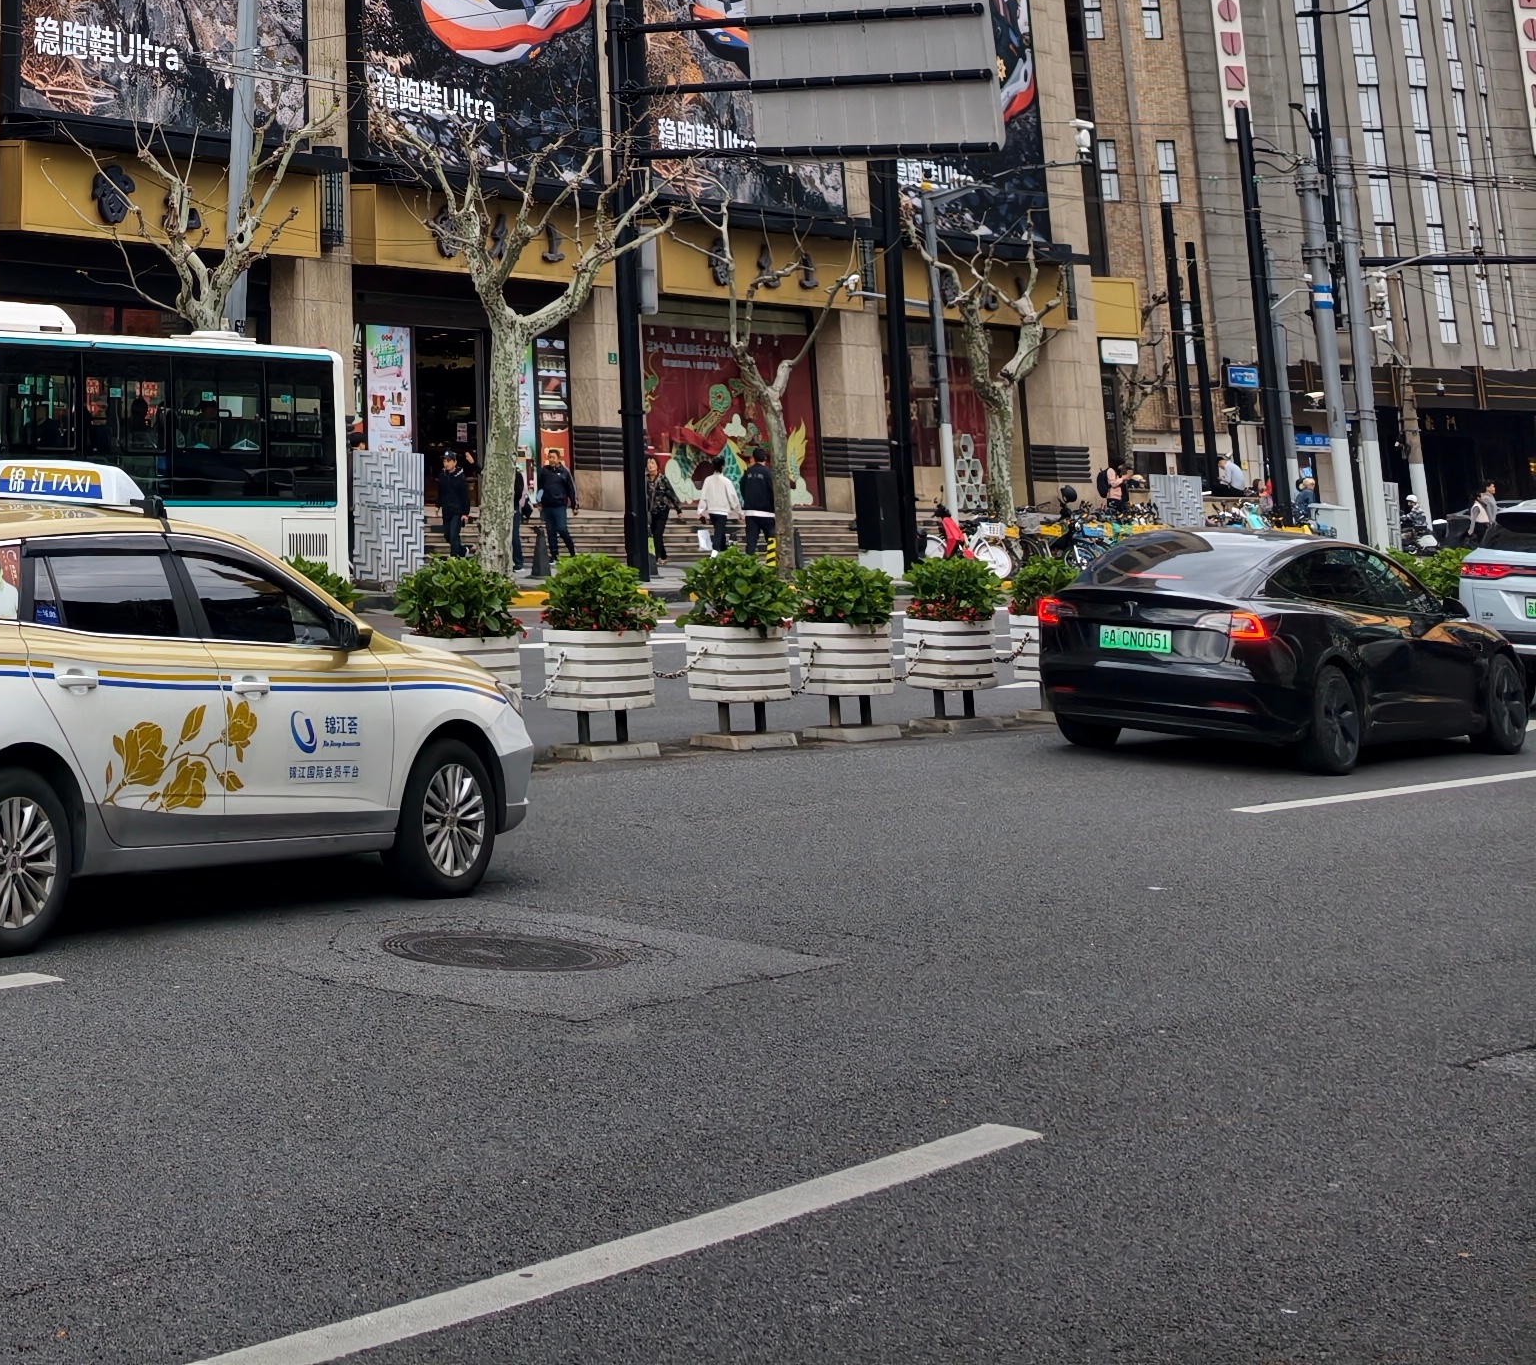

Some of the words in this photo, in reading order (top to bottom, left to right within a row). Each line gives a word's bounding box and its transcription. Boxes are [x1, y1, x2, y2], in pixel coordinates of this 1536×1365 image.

[324, 715, 359, 735] 锦江荟
[289, 765, 360, 780] 锦江国际会员平台
